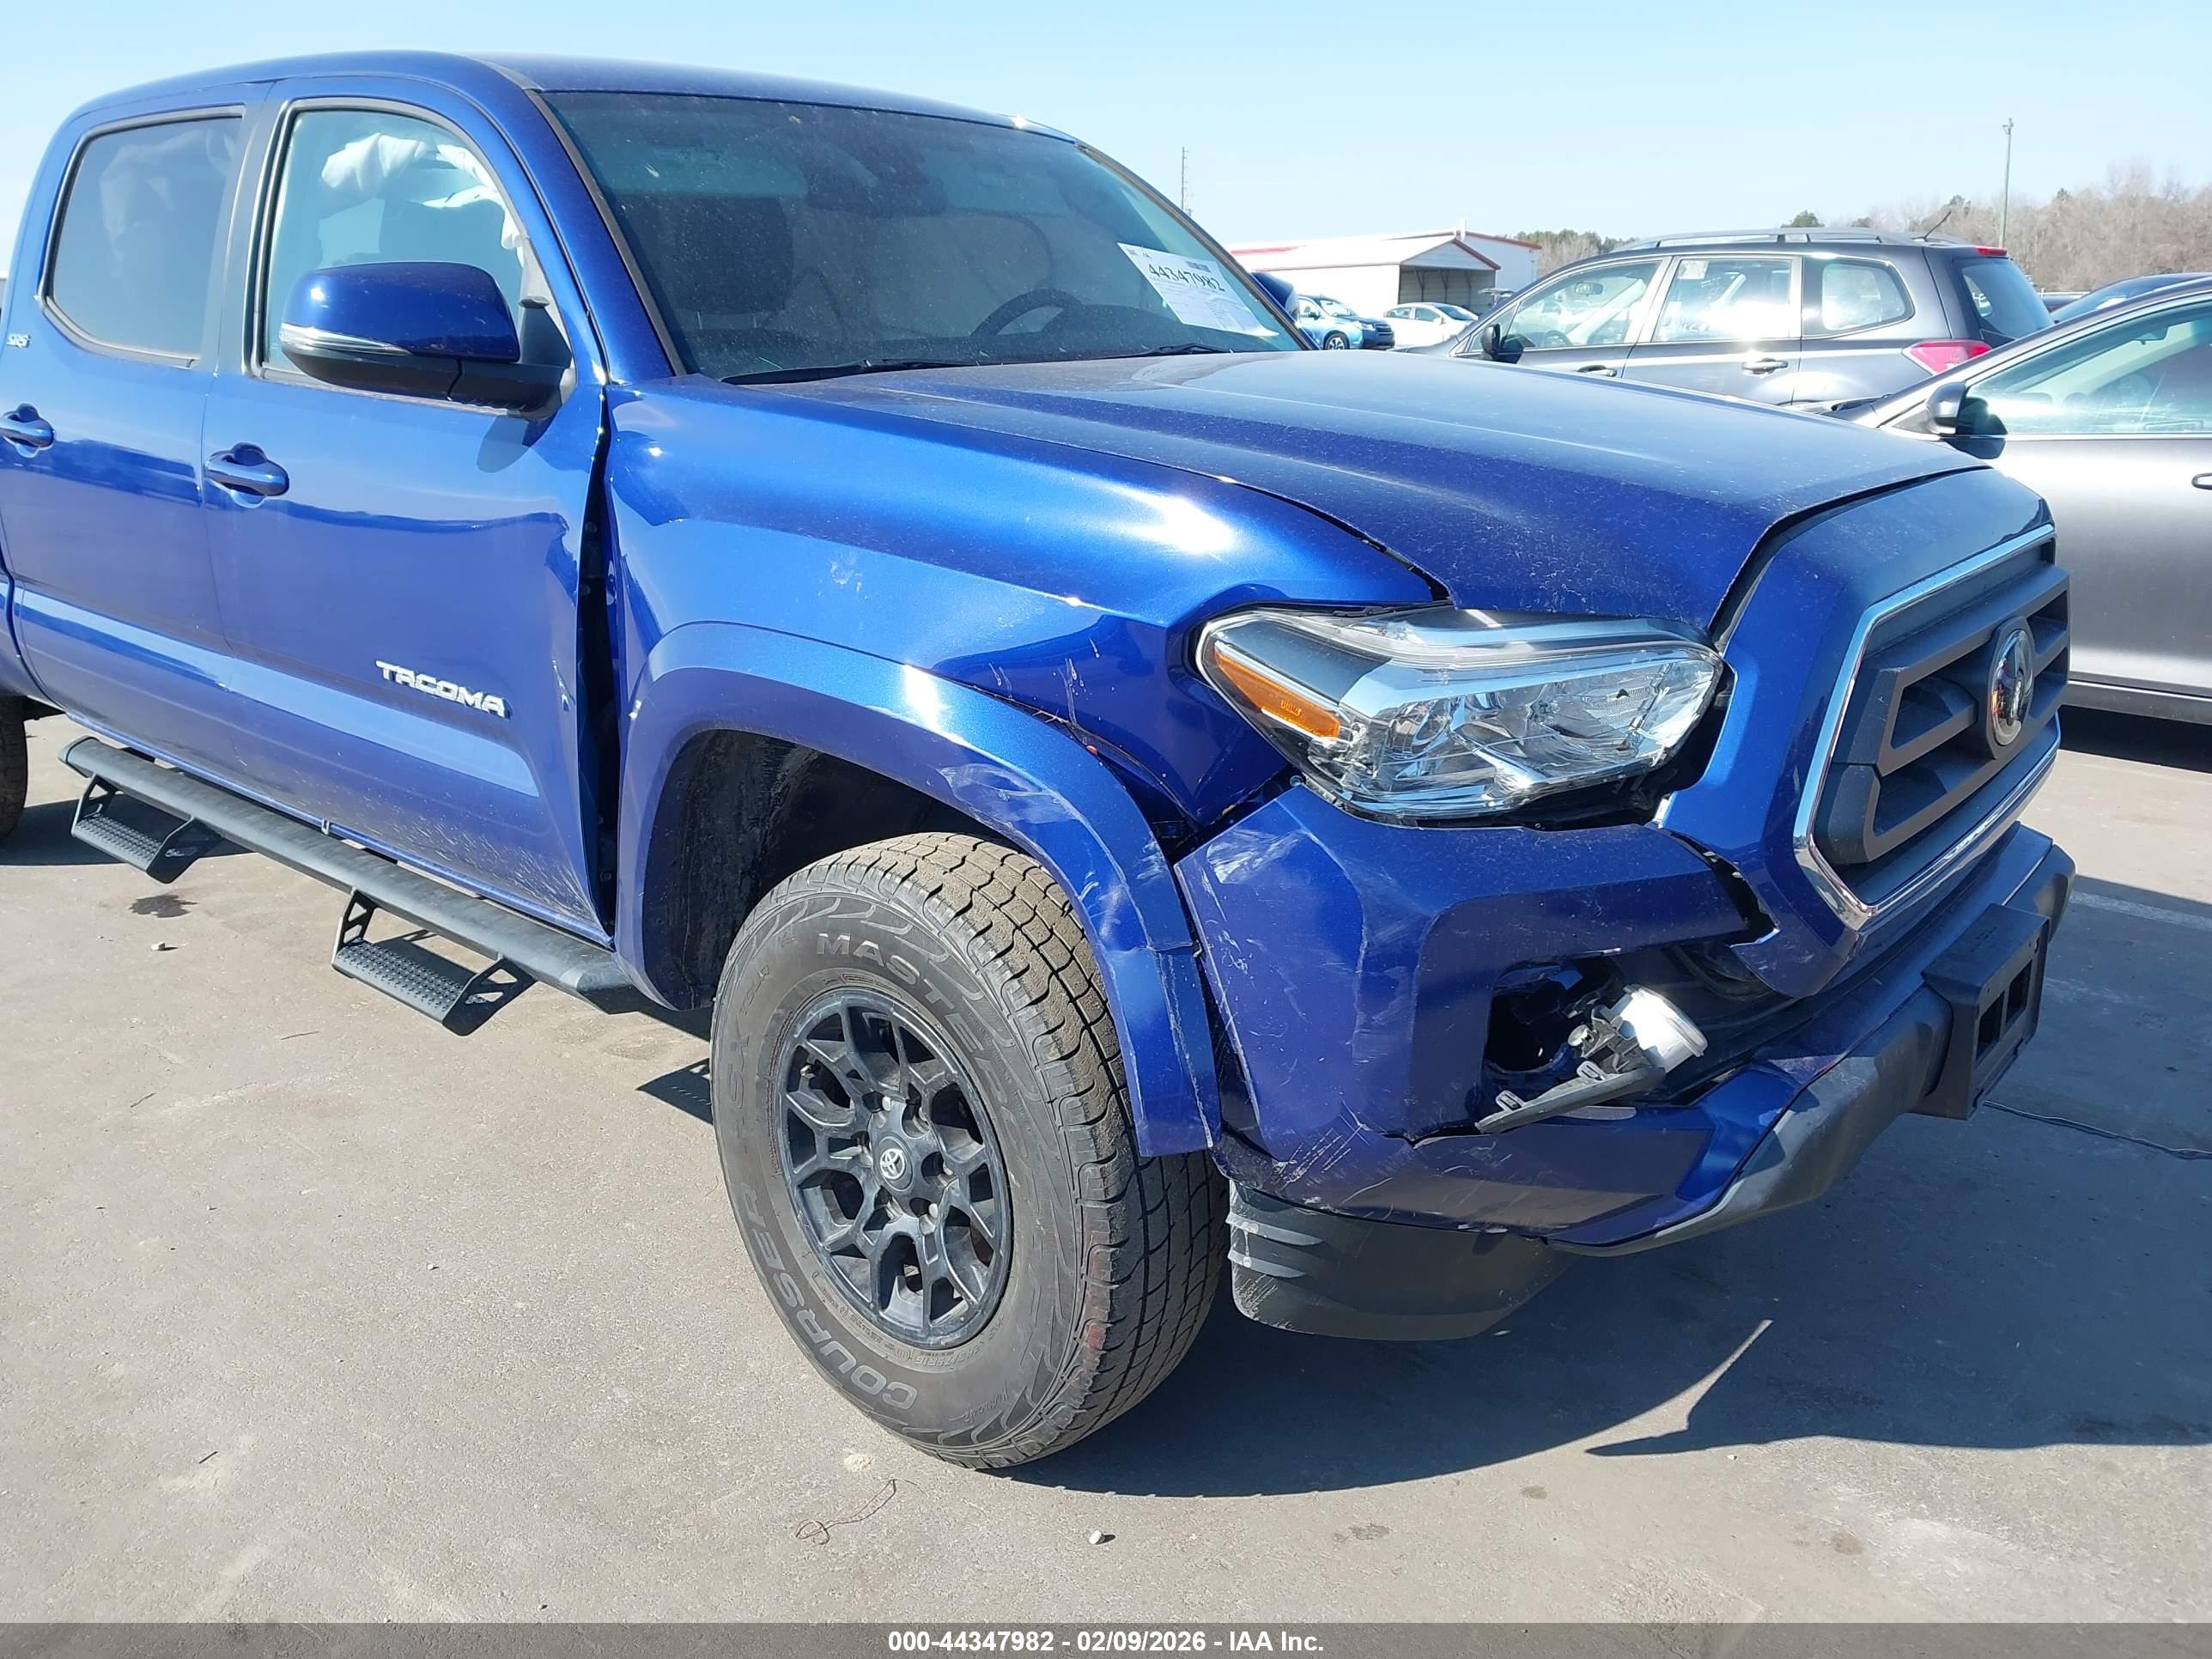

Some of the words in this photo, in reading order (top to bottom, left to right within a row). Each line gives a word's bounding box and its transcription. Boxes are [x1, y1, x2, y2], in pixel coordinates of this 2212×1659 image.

[1148, 263, 1226, 293] 44347982
[374, 659, 508, 719] TACOMA
[740, 1182, 917, 1411] COURSER
